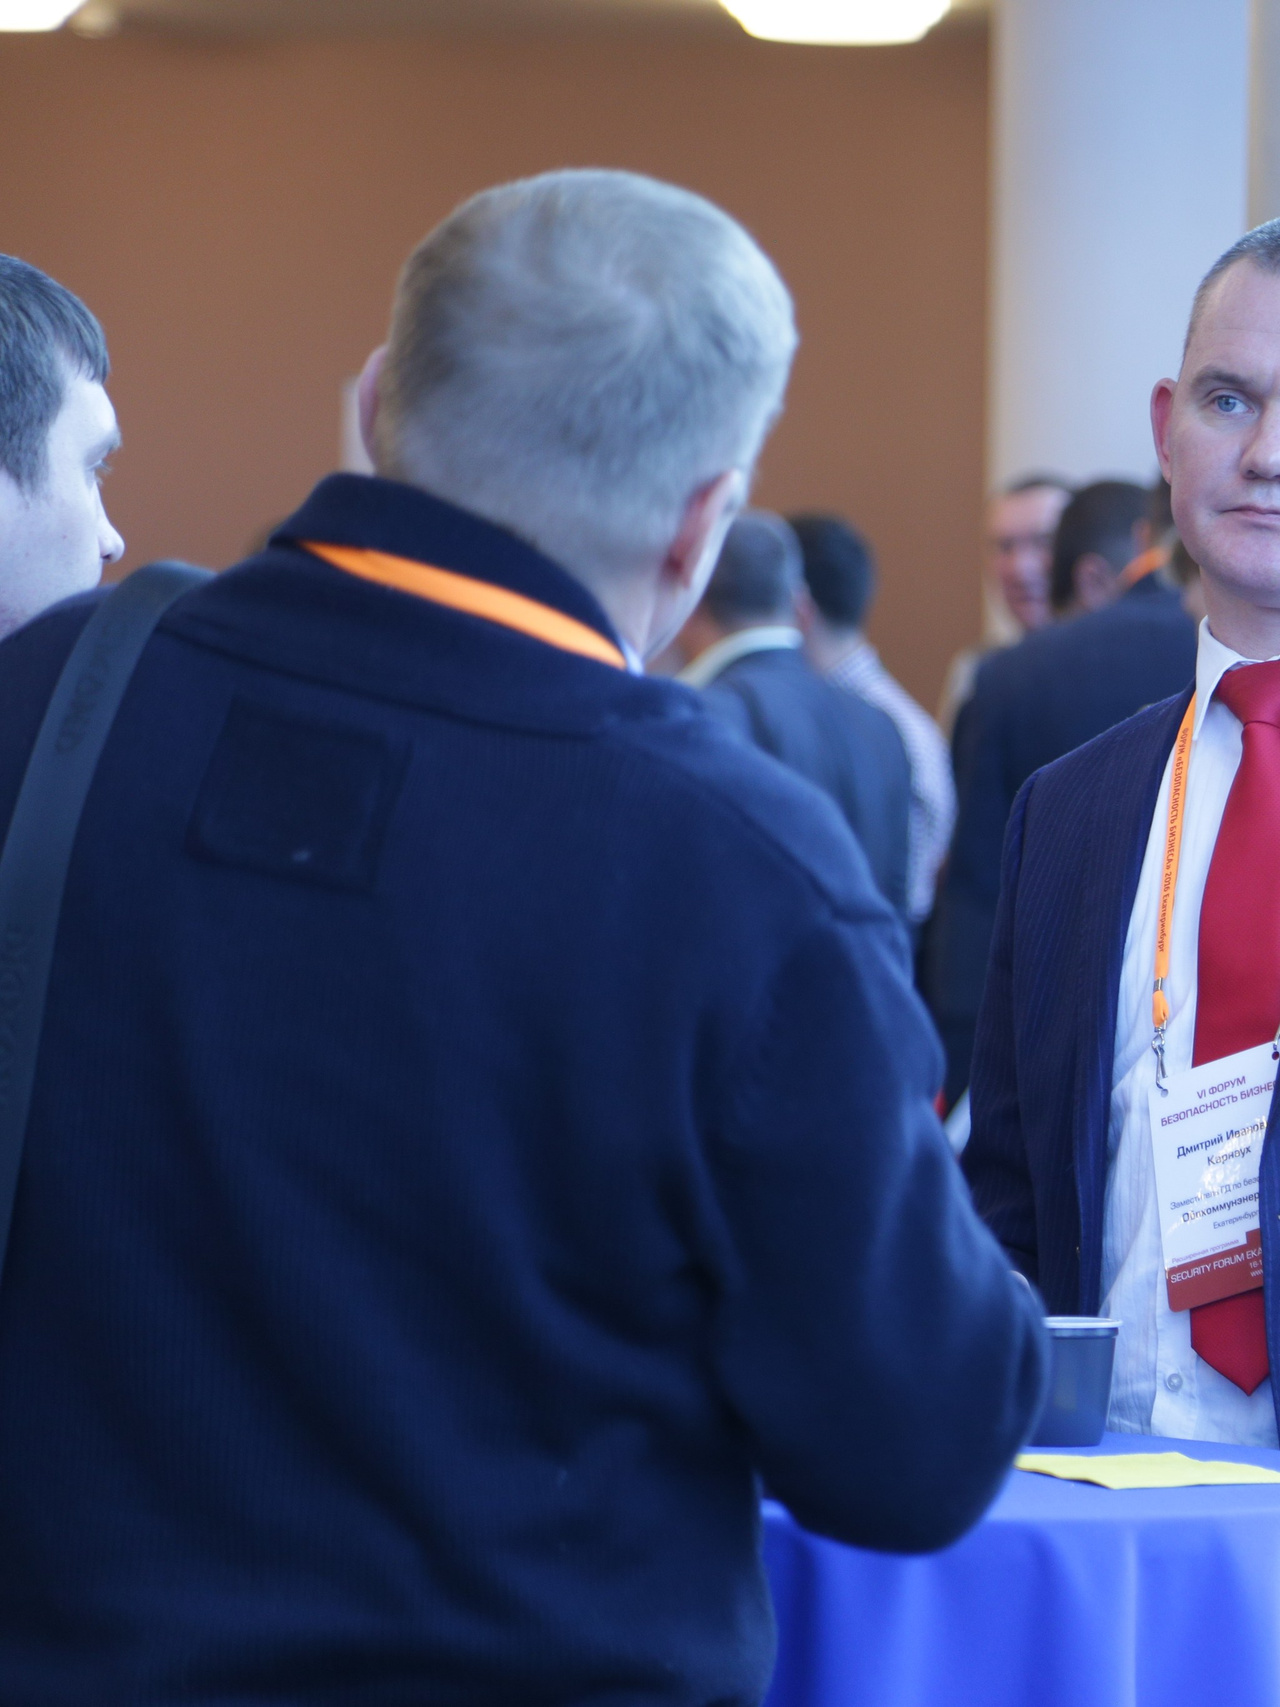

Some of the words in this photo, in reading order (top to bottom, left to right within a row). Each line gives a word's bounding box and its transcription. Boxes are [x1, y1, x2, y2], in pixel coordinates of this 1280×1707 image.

[1178, 727, 1189, 755] ФОРУМ
[1163, 872, 1172, 893] 2016
[1158, 893, 1170, 952] Екатеринбург
[1197, 1089, 1206, 1099] VI
[1208, 1075, 1246, 1095] ФОРУМ
[1161, 1095, 1238, 1127] БЕЗОПАСНОСТЬ
[1176, 1133, 1223, 1159] Дмитрий
[1170, 1263, 1212, 1284] SECURITY
[1213, 1253, 1245, 1270] FORUM
